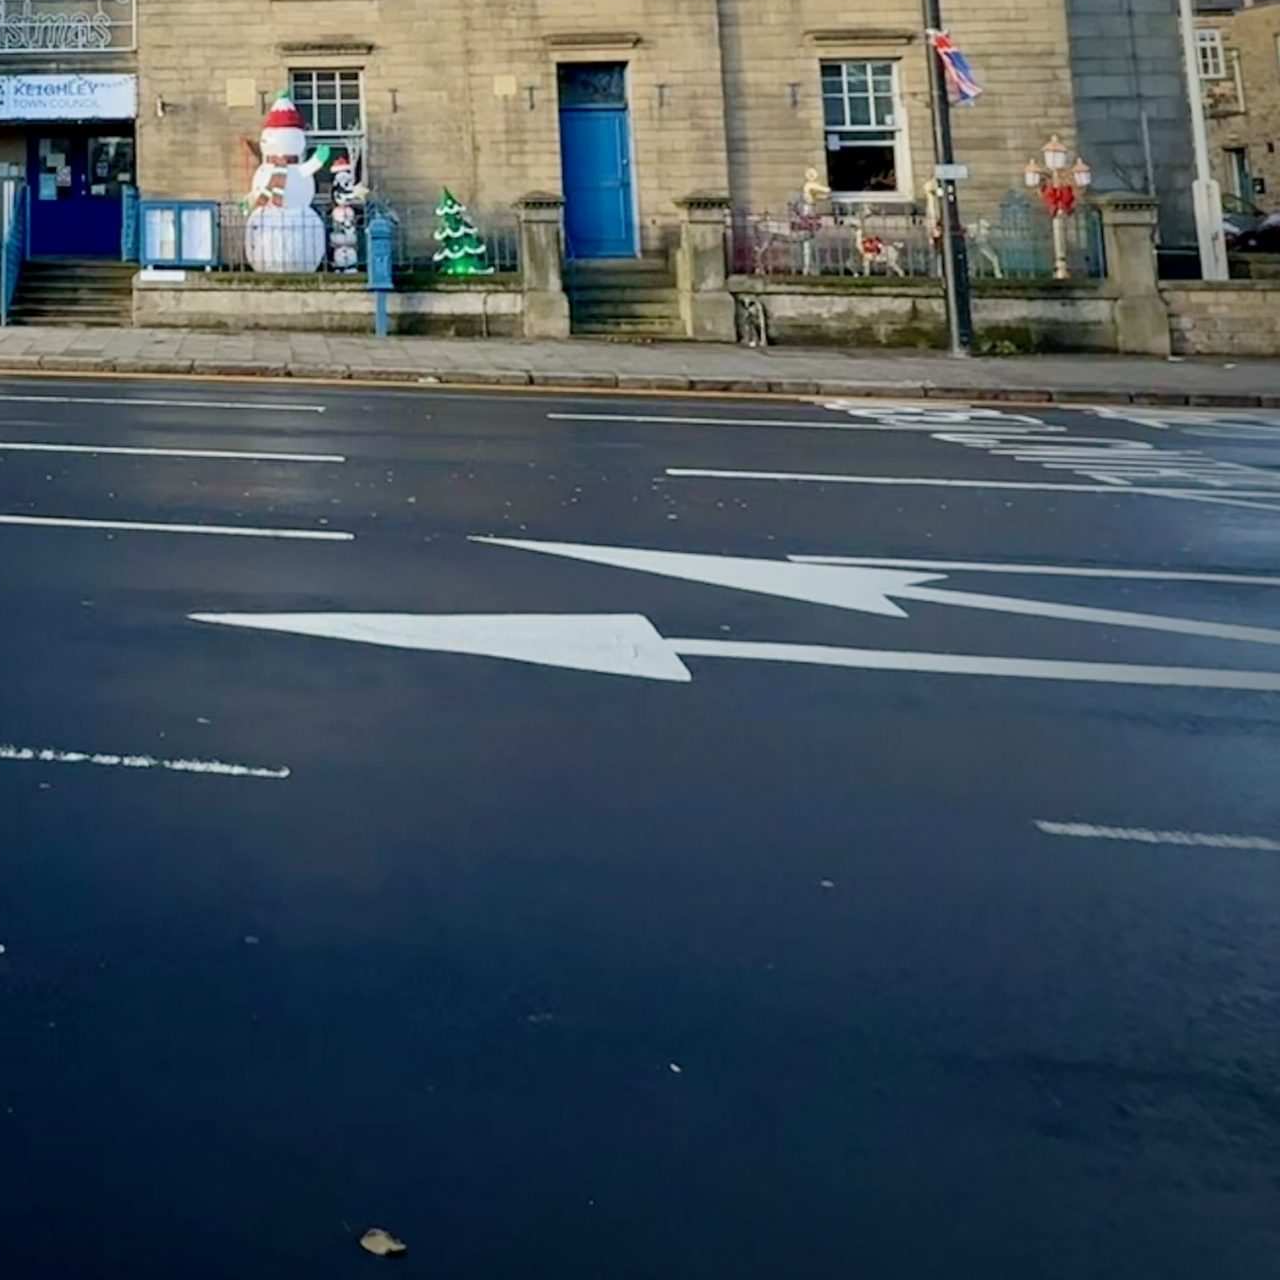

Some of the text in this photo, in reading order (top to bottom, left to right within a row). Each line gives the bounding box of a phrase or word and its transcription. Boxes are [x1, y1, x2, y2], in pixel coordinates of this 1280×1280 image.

[14, 82, 97, 97] KEIGHLEY
[13, 98, 101, 110] TOWN COUNCIL
